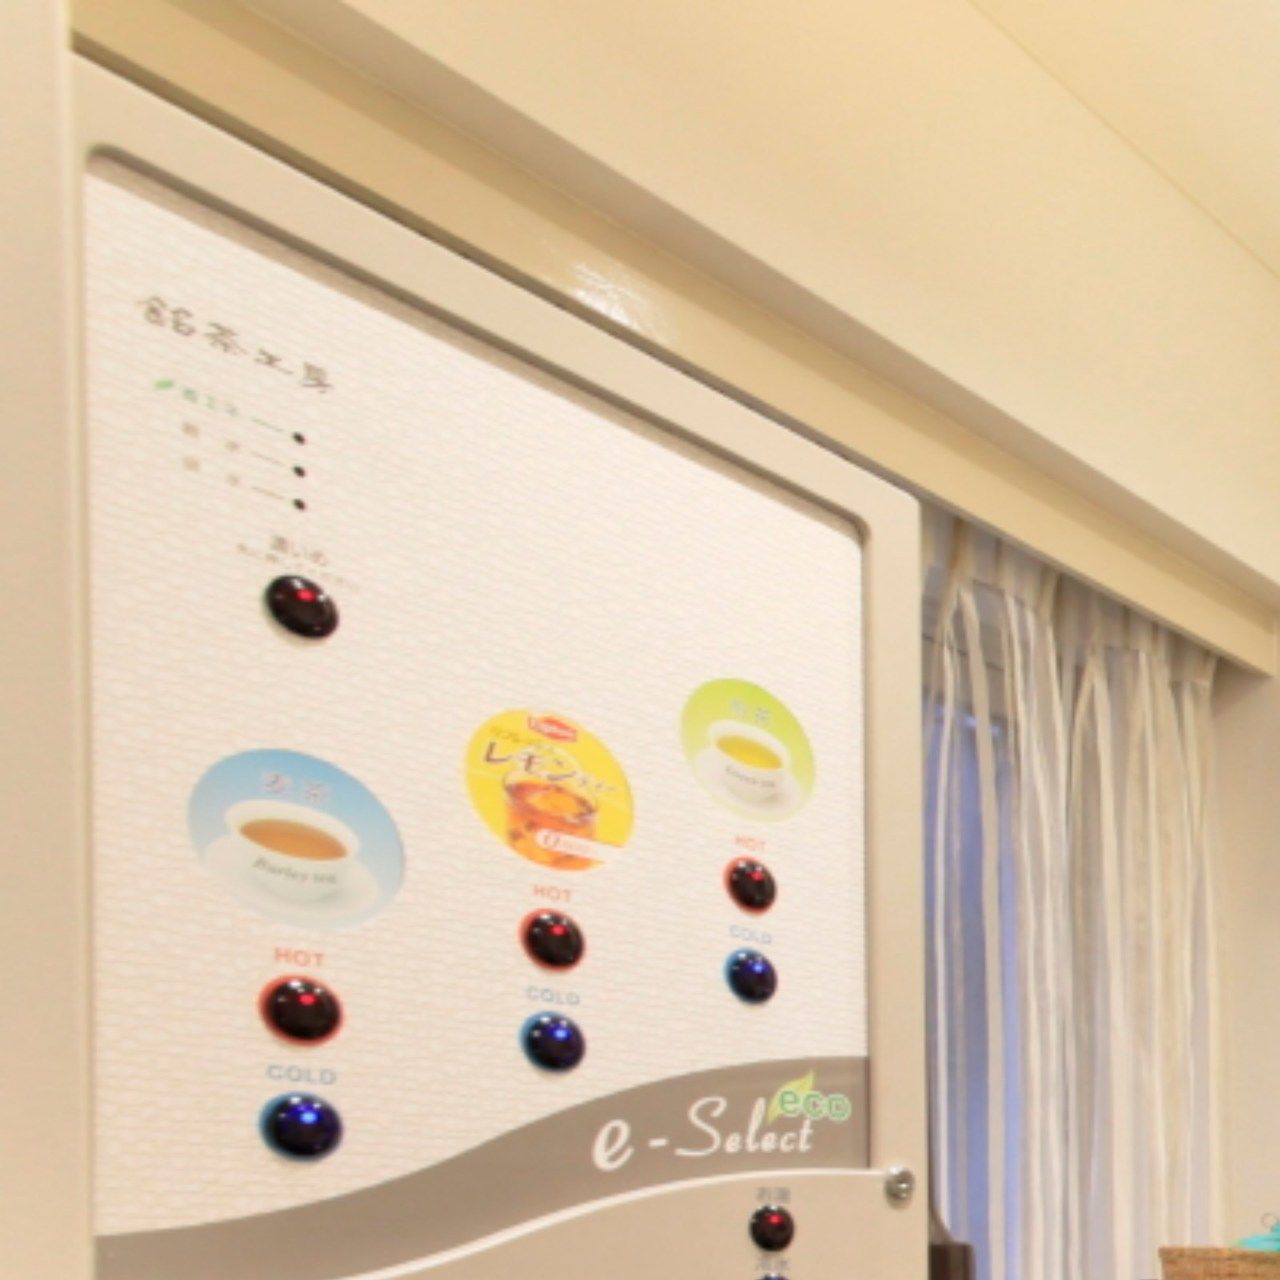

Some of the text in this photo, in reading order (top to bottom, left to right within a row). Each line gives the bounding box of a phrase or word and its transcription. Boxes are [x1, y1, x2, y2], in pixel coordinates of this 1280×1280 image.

[532, 884, 572, 902] HOT
[273, 947, 326, 968] HOT
[526, 985, 582, 1006] COLD
[265, 1064, 337, 1086] COLD
[779, 1090, 852, 1121] eco
